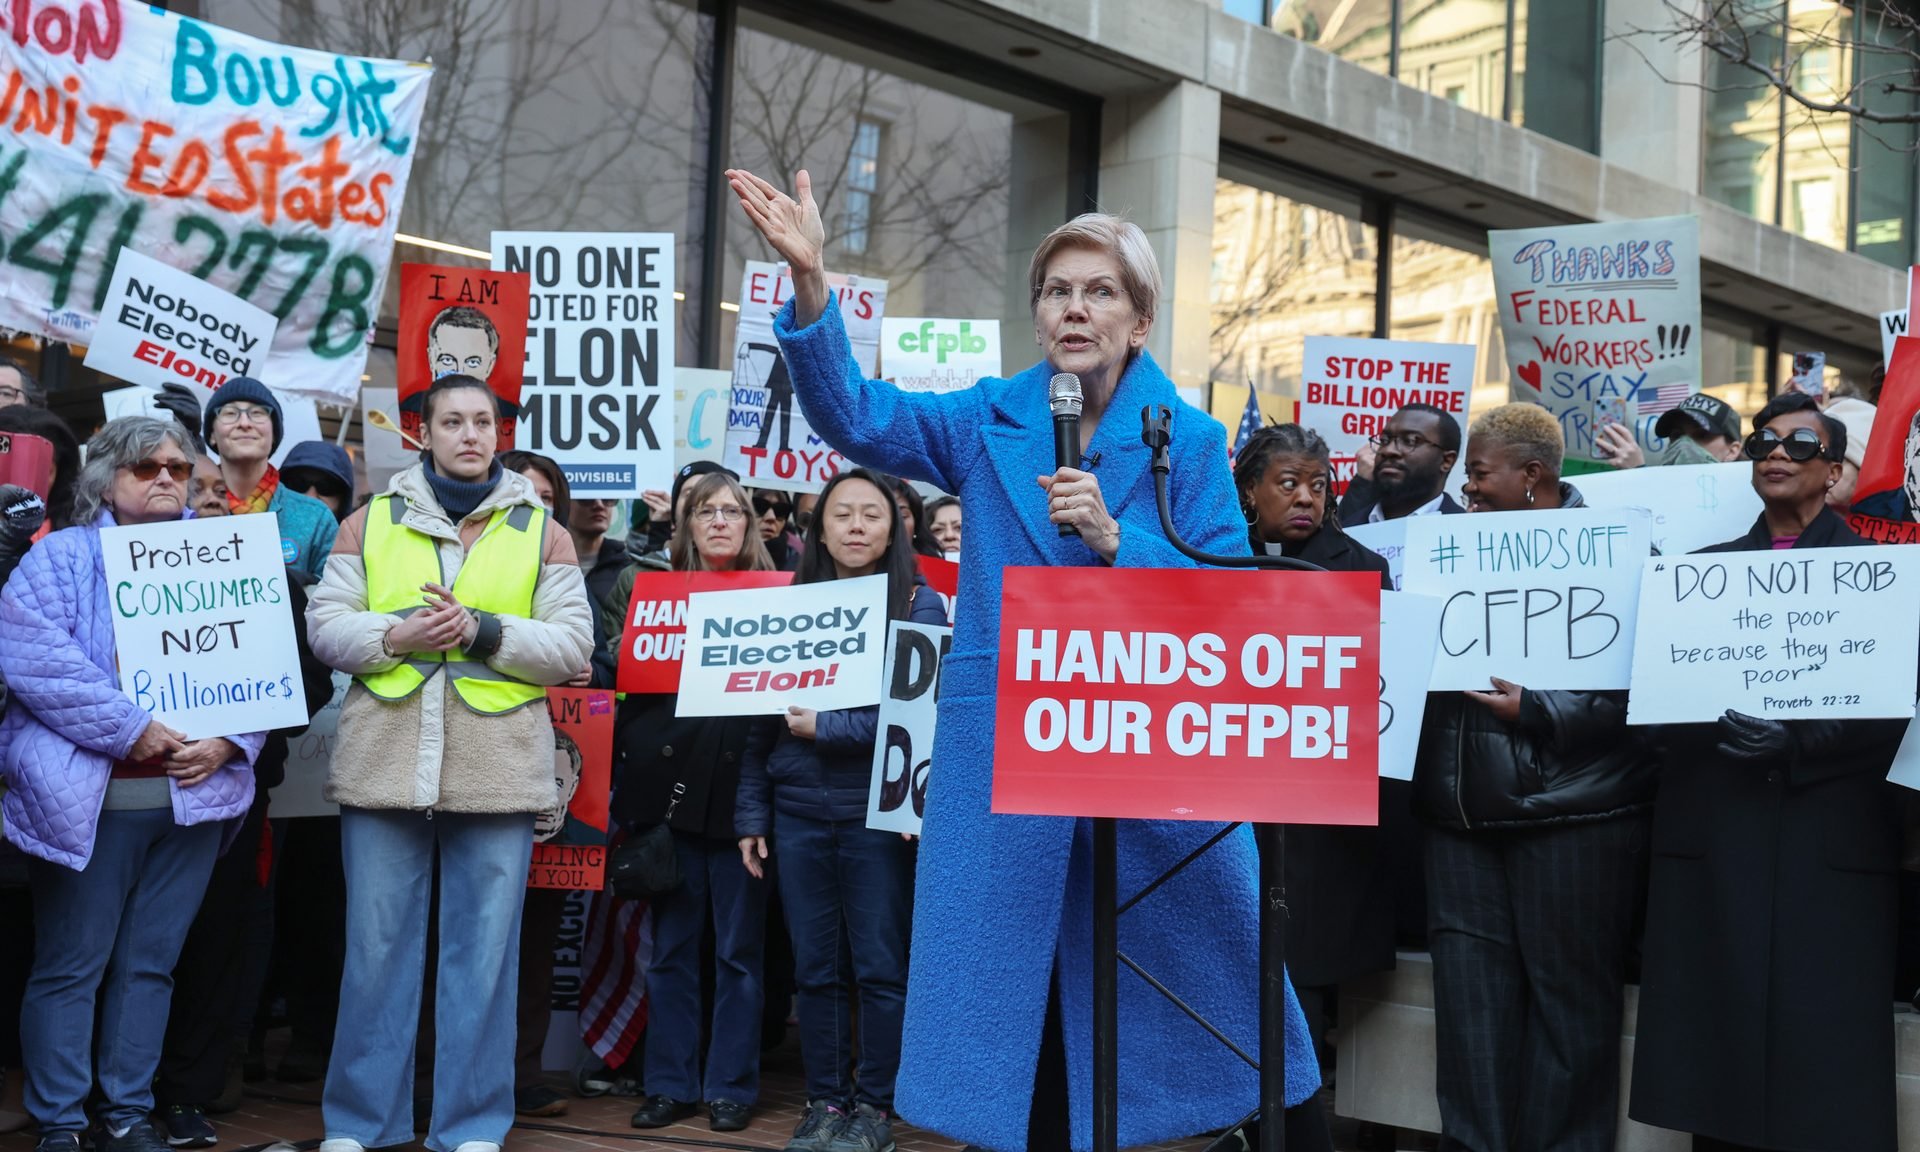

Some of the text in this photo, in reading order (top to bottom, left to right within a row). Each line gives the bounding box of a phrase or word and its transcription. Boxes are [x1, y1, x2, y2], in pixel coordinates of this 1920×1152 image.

[171, 18, 410, 155] Bought
[205, 120, 393, 230] States
[504, 245, 661, 289] NO ONE
[1513, 239, 1675, 283] THANKS
[427, 274, 499, 305] I AM
[1510, 289, 1646, 325] FEDERAL
[125, 277, 259, 354] Nobody
[527, 294, 658, 322] OTED FOR
[117, 303, 252, 377] Elected
[898, 321, 987, 363] cfpb
[132, 339, 228, 392] Elon!
[1325, 356, 1451, 384] STOP THE
[732, 387, 765, 408] YOUR
[1307, 382, 1465, 413] BILLIONAIRE
[1550, 371, 1648, 401] STAY
[519, 394, 661, 450] MUSK
[729, 408, 761, 430] DATA
[1341, 412, 1391, 436] GRI
[565, 471, 633, 483] DIVISIBLE
[740, 445, 845, 482] TOYS
[1850, 515, 1917, 544] STEA
[129, 532, 244, 572] Protect
[1747, 559, 1815, 597] NOT
[1833, 560, 1896, 594] ROB
[116, 577, 281, 618] CONSUMERS
[632, 600, 689, 627] HAN
[702, 606, 869, 640] Nobody
[1440, 586, 1620, 660] CFPB
[1732, 607, 1840, 633] the poor
[700, 632, 866, 667] Elected
[1015, 628, 1362, 689] HANDS OFF
[1671, 637, 1876, 665] because they are
[133, 669, 293, 712] Billionaire$
[724, 663, 840, 693] Elon!
[1763, 694, 1861, 711] Proverb 22:22
[1023, 697, 1152, 755] OUR
[1166, 701, 1349, 760] CFPB!
[530, 845, 603, 867] LING
[543, 870, 590, 887] YOU.
[551, 975, 581, 1011] NO
